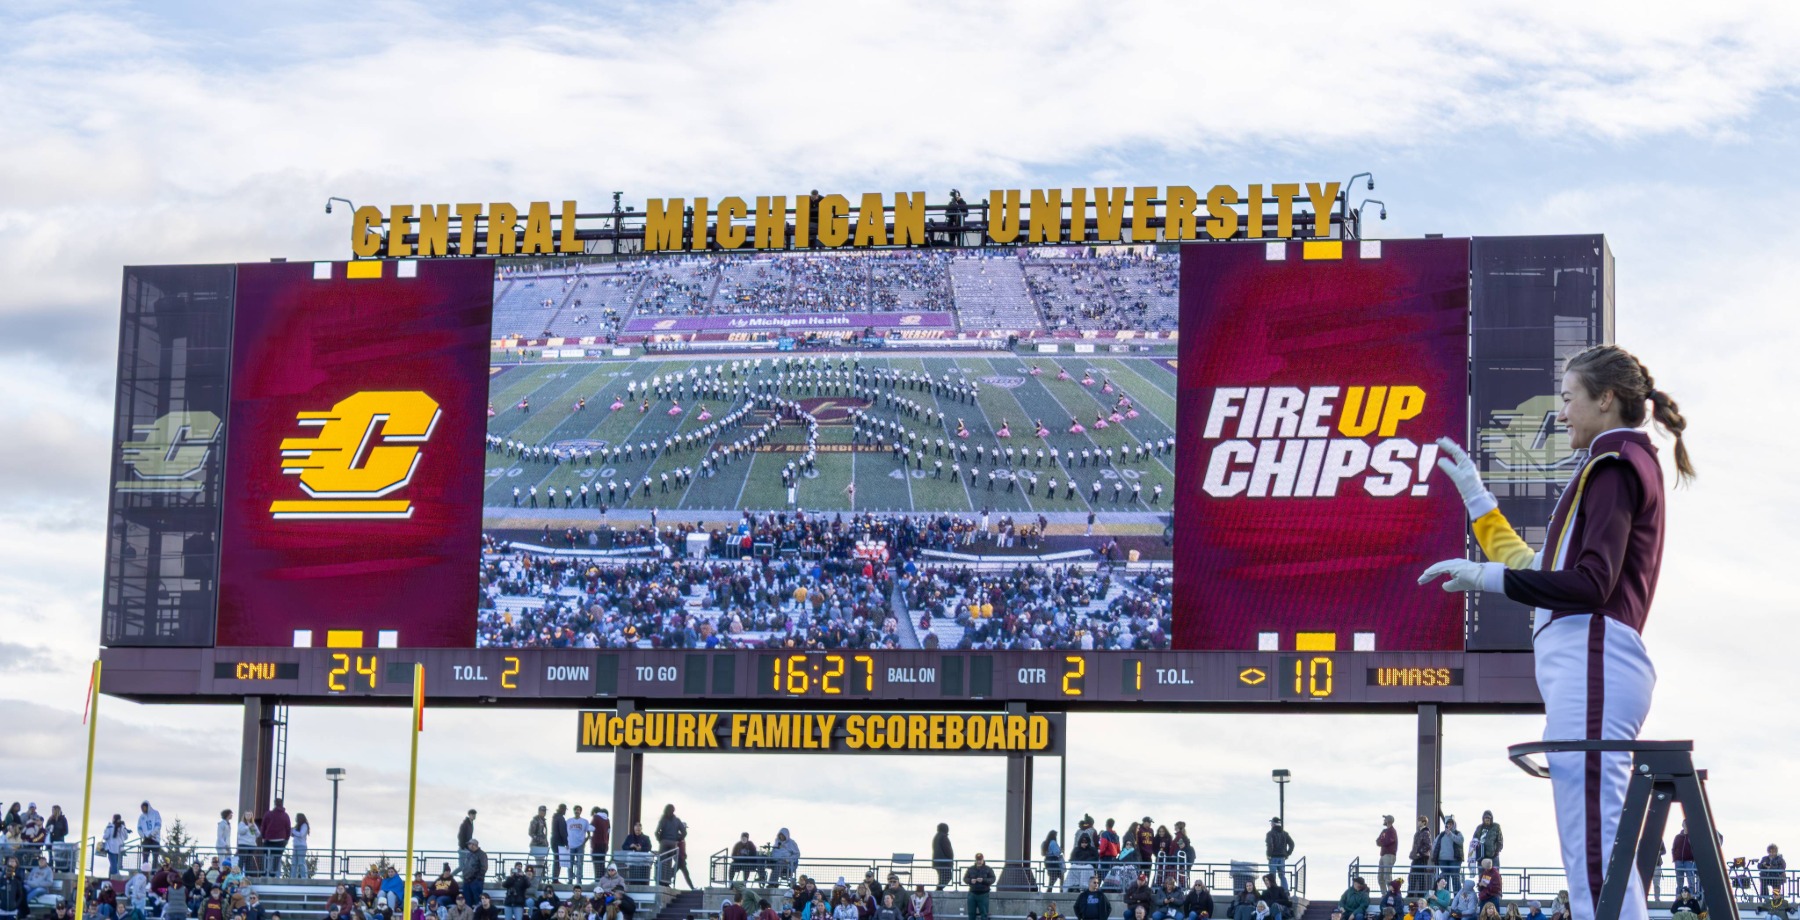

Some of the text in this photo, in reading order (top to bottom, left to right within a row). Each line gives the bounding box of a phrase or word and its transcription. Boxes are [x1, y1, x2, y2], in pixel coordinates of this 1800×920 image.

[353, 182, 1342, 257] CENTRAL MICHIGAN UNIVERSITY
[749, 317, 806, 326] Michigan
[808, 316, 850, 324] Health
[1203, 385, 1426, 438] FIRE UP
[1203, 438, 1438, 498] CHIPS!
[236, 662, 276, 680] CMU
[328, 653, 377, 691] 24
[453, 657, 519, 688] T.O.L. 2
[547, 666, 589, 681] DOWN
[636, 667, 677, 682] TO GO
[773, 655, 874, 694] 16:27
[887, 667, 936, 682] BALL ON
[1018, 656, 1085, 695] QTR 2
[1136, 661, 1194, 690] 1 T.O.L.
[1295, 656, 1332, 696] 10
[1378, 668, 1450, 686] UMASS
[582, 712, 1049, 750] McGUIRK FAMILY SCOREBOARD
